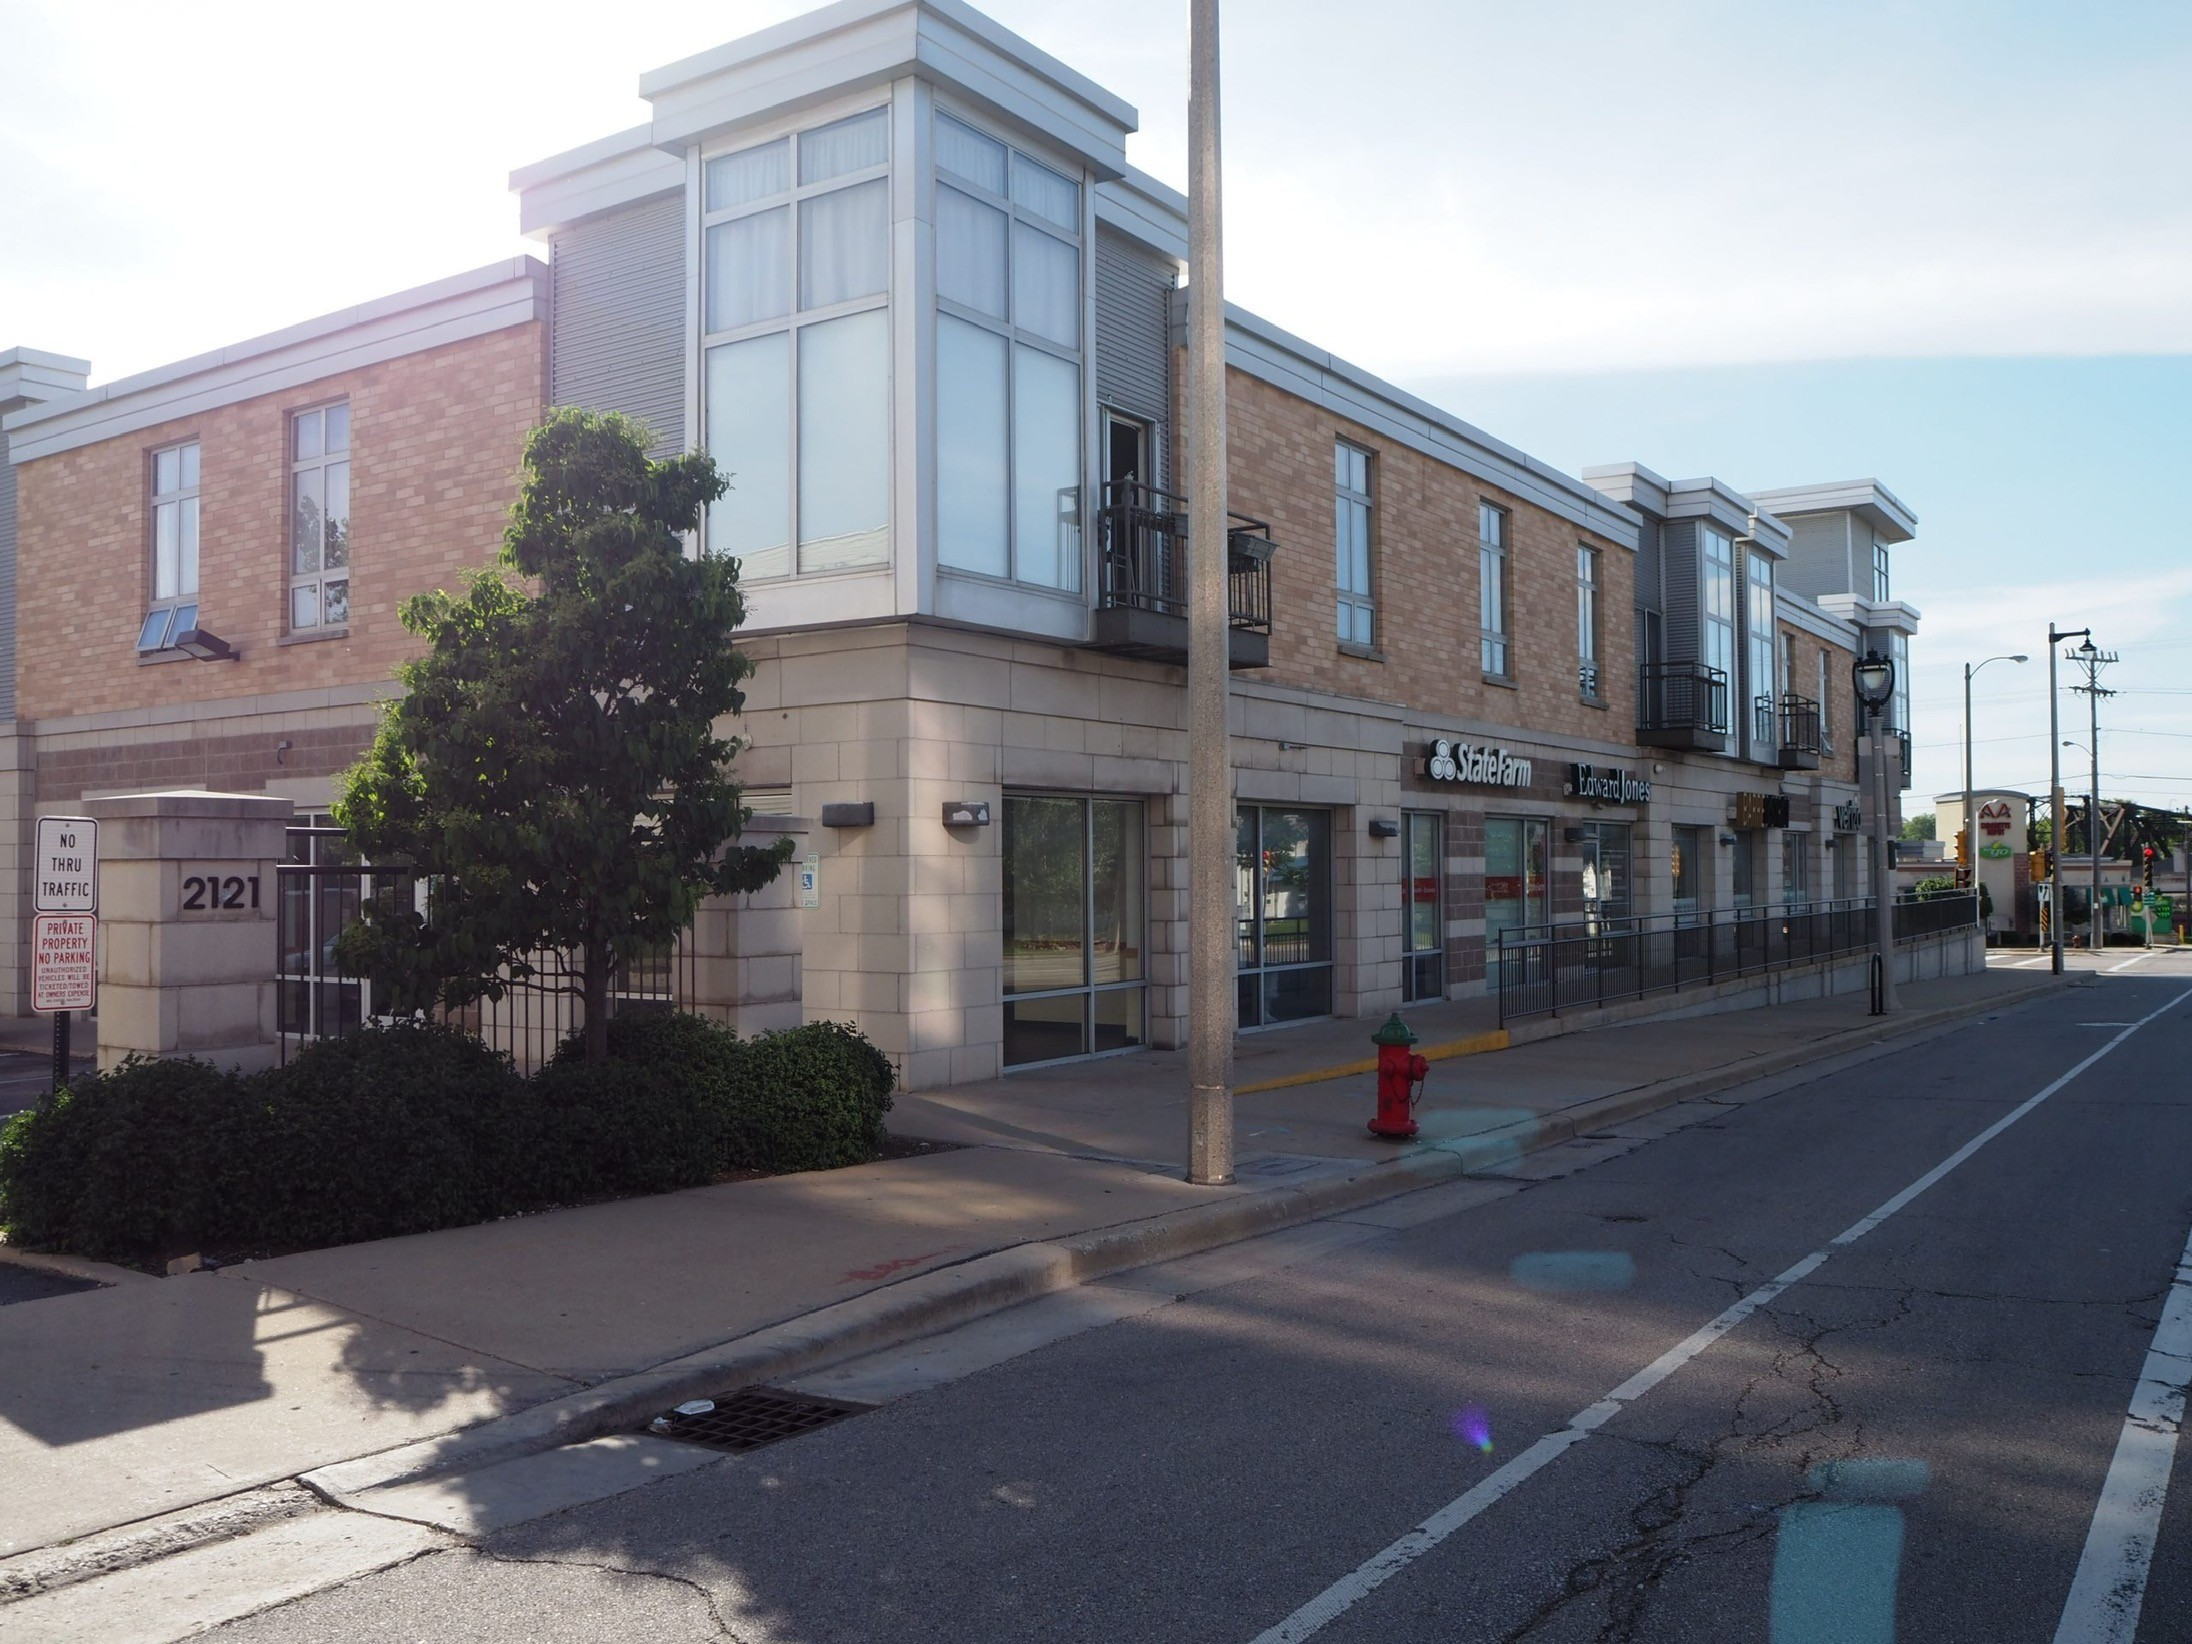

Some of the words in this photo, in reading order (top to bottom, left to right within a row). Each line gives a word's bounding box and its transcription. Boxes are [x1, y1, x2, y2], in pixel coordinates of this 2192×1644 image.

[60, 834, 75, 848] NO
[52, 857, 82, 872] THRU
[42, 882, 89, 897] TRAFFIC
[183, 877, 259, 910] 2121
[47, 922, 84, 935] PRIVATE
[42, 938, 88, 950] PROPERTY
[39, 952, 51, 964] NO
[53, 952, 90, 964] PARKING
[41, 966, 87, 974] UNAUTHORIZED
[38, 974, 65, 982] VEHICLES
[39, 982, 88, 991] TICKETED/TOWED
[46, 990, 66, 998] OWNERS
[67, 989, 90, 997] EXPENSE
